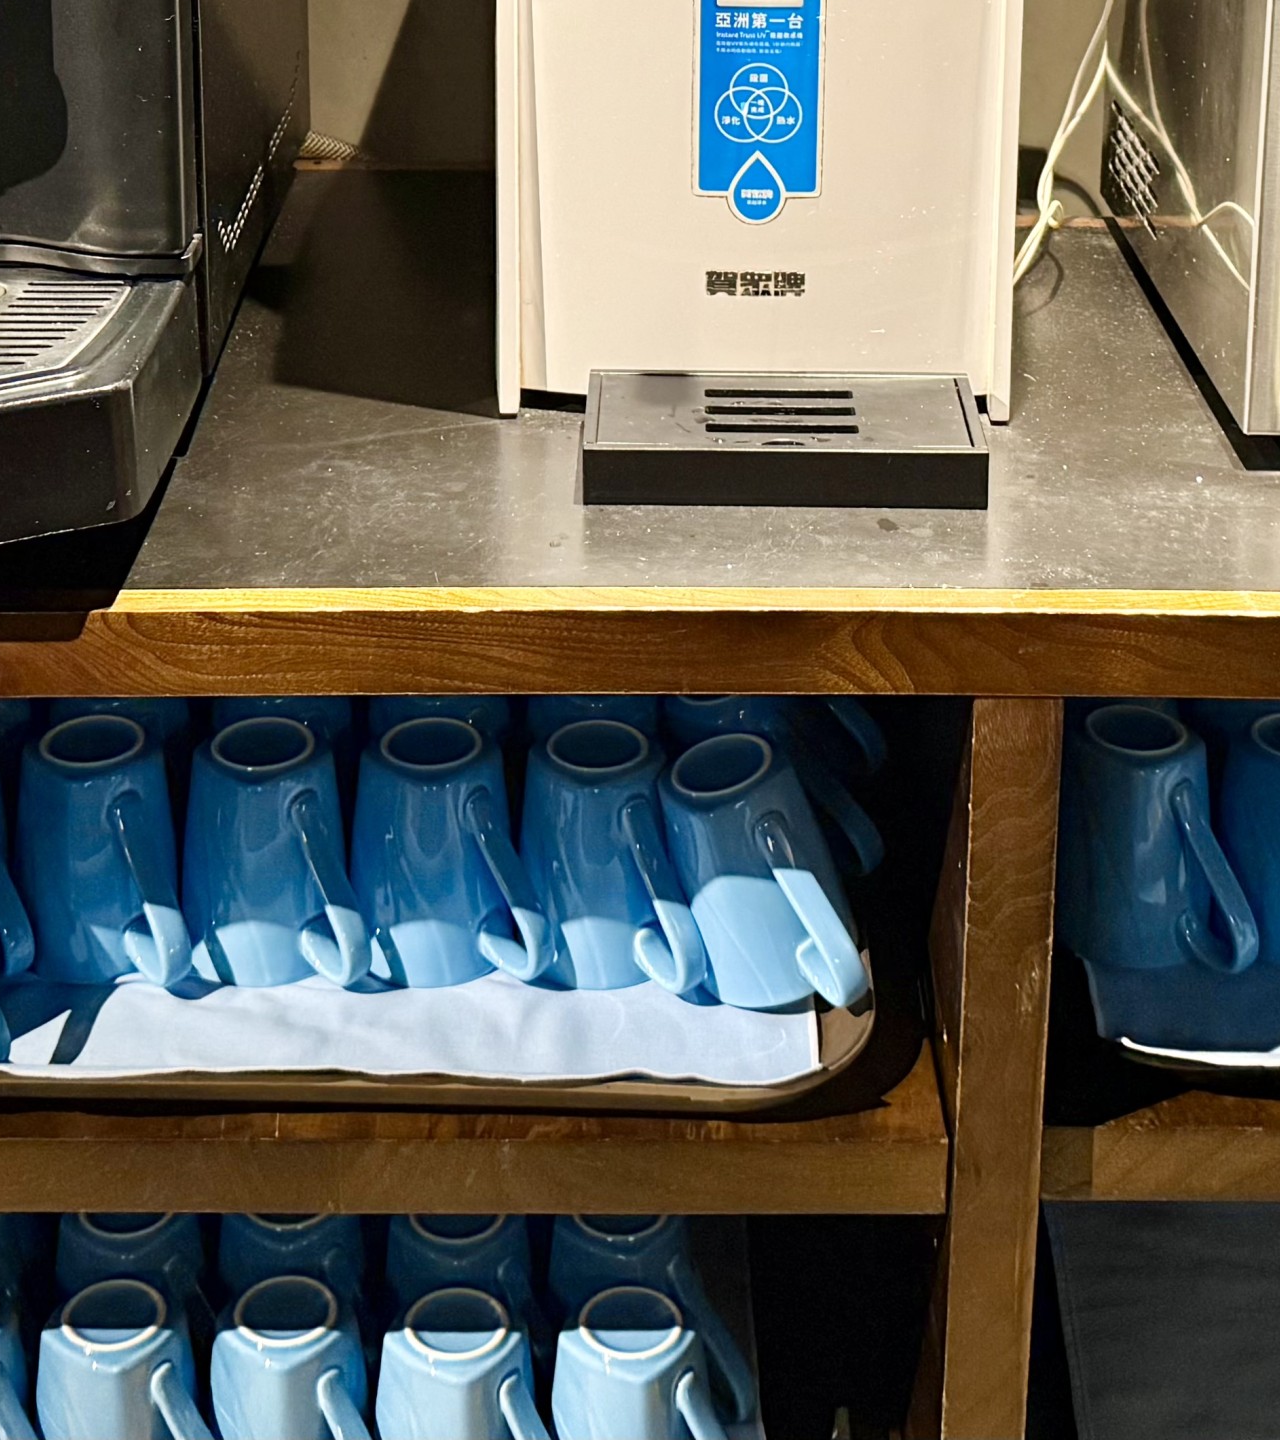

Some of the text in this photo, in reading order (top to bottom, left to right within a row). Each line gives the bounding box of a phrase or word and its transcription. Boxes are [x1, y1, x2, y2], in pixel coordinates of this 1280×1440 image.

[715, 12, 804, 29] 亞洲第一台
